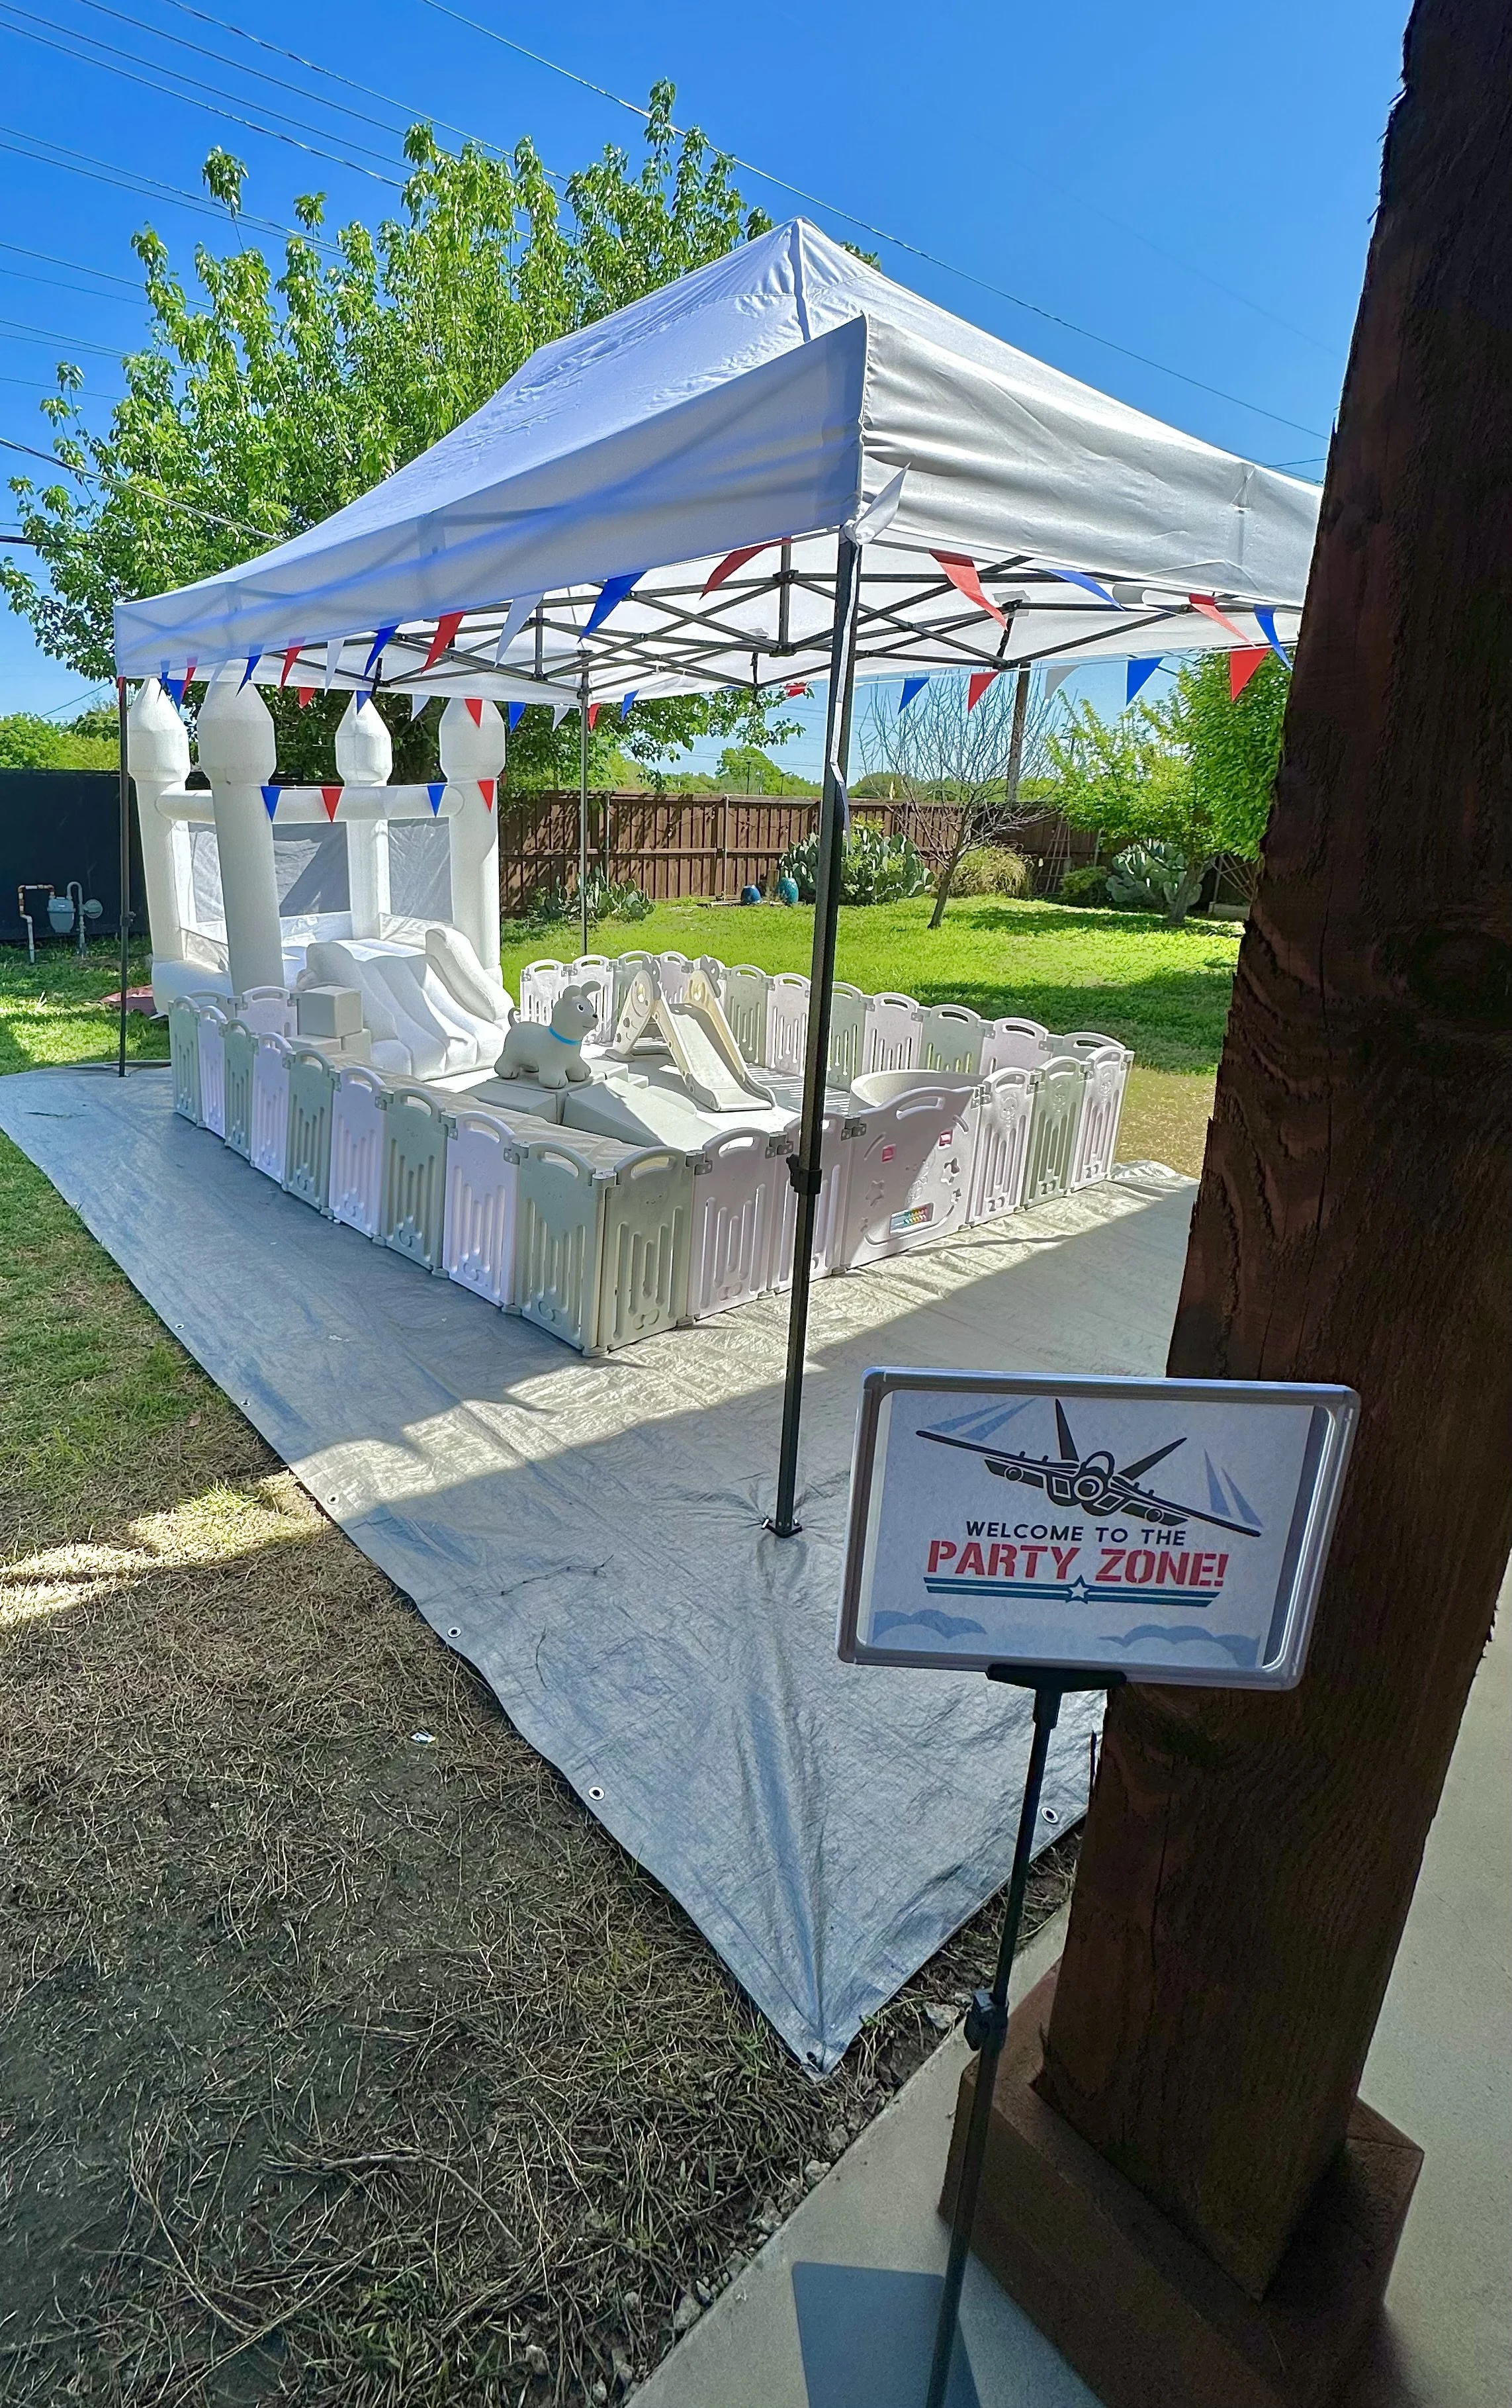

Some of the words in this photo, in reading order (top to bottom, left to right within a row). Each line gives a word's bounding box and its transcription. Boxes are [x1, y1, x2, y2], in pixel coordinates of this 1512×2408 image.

[965, 1520, 1084, 1542] WELCOME
[1095, 1527, 1128, 1543] TO
[1141, 1529, 1186, 1546] THE
[927, 1540, 1081, 1579] PARTY
[1095, 1548, 1229, 1587] ZONE!
